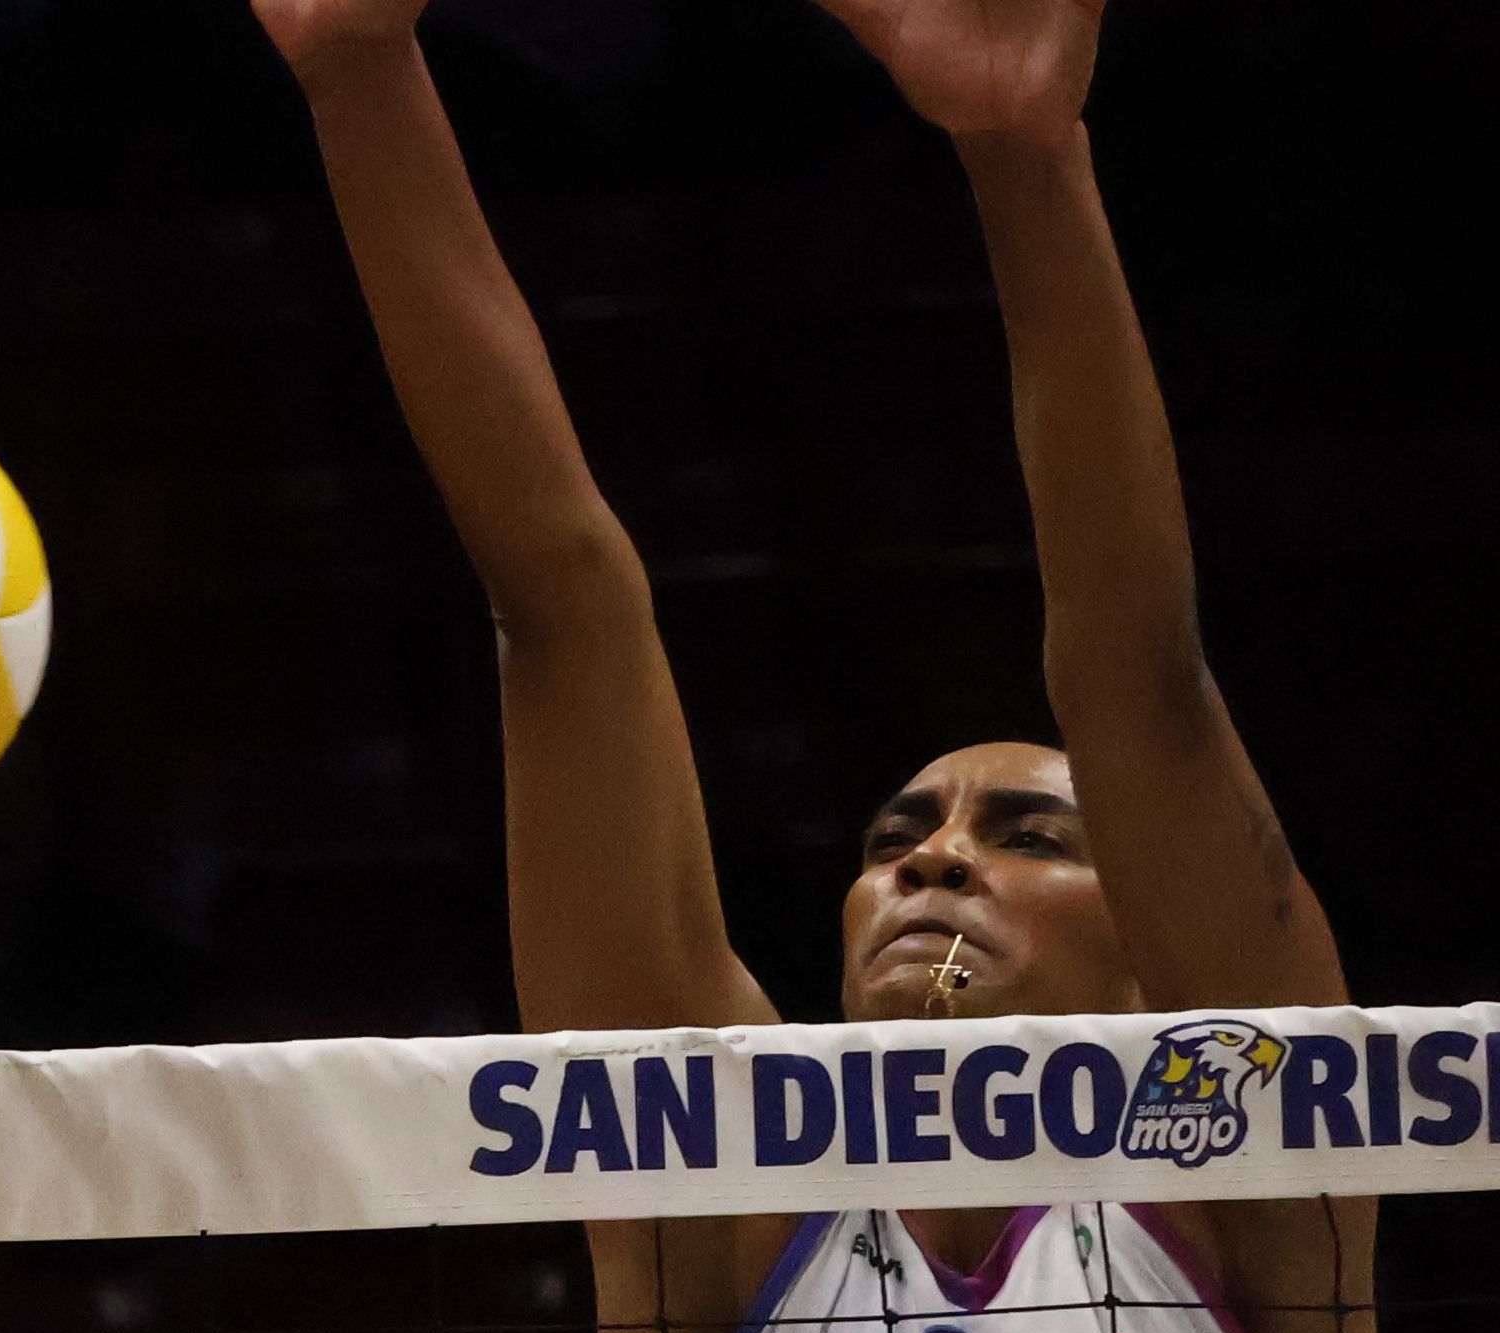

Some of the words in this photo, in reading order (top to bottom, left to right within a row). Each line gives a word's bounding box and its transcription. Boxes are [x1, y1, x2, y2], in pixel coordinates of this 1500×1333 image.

[468, 1055, 718, 1177] SAN
[751, 1042, 1128, 1168] DIEGO
[1127, 1114, 1238, 1162] mojo
